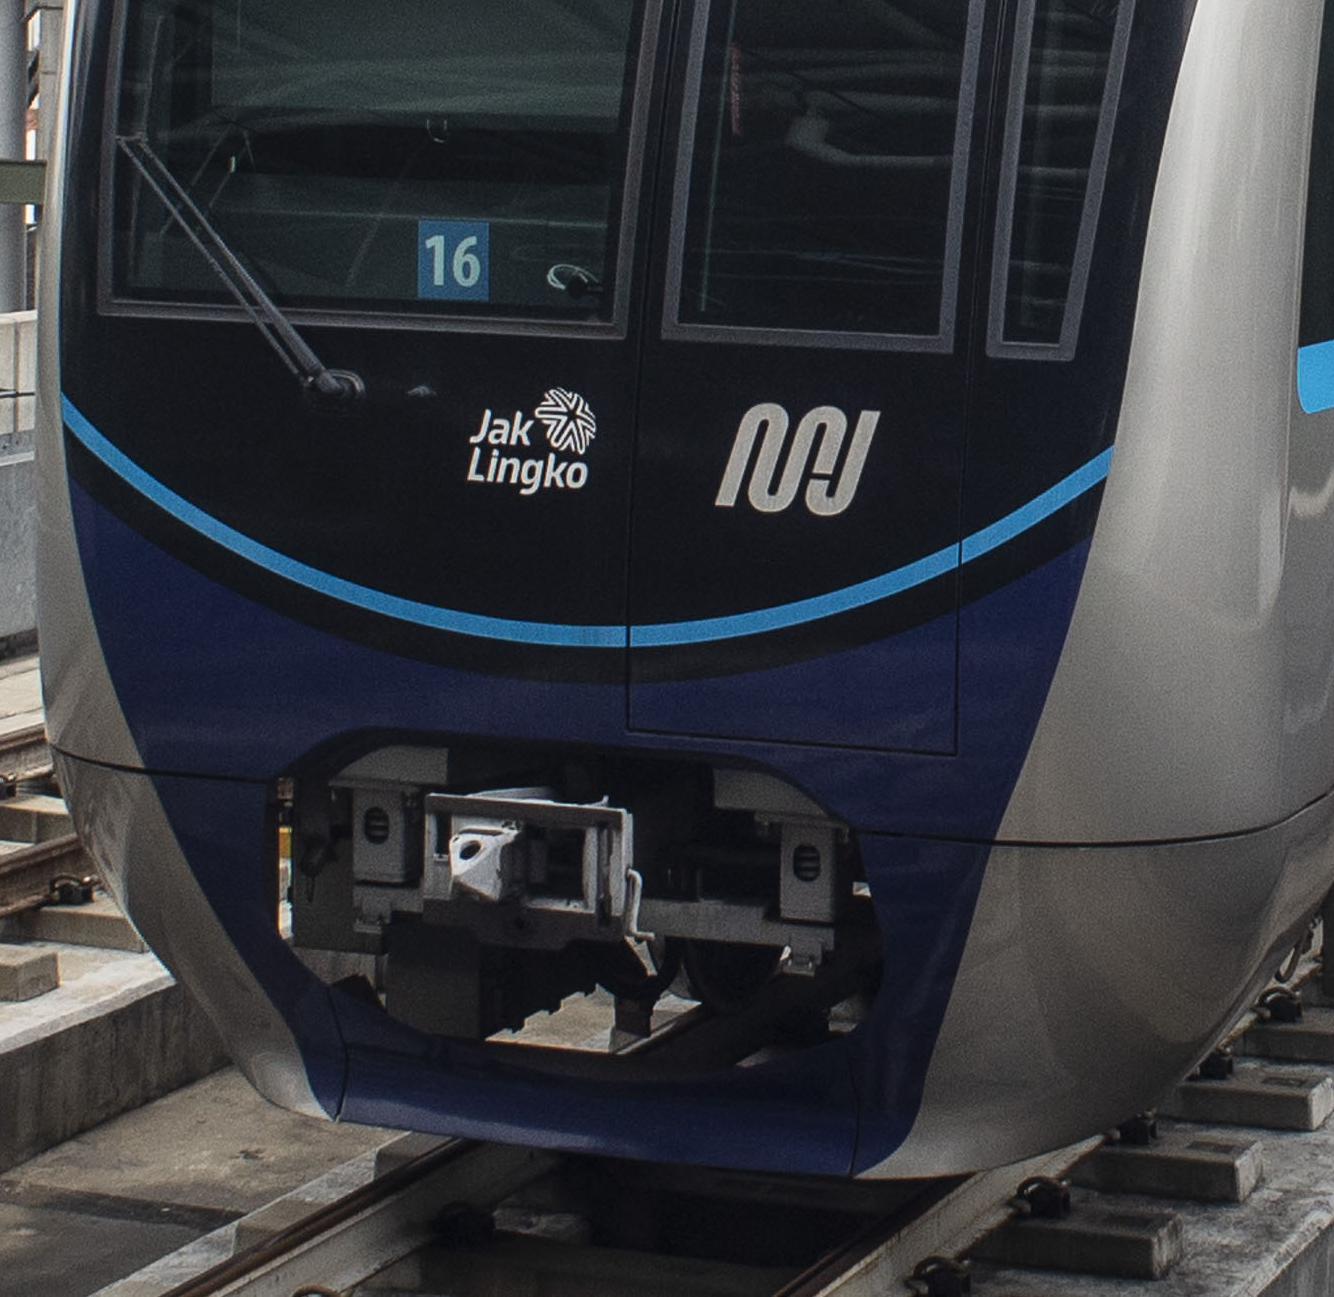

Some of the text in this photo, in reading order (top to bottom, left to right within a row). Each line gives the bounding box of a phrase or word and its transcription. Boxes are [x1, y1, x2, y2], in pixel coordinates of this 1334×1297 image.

[425, 234, 481, 287] 16
[470, 409, 535, 446] Jak
[467, 447, 589, 496] Lingko
